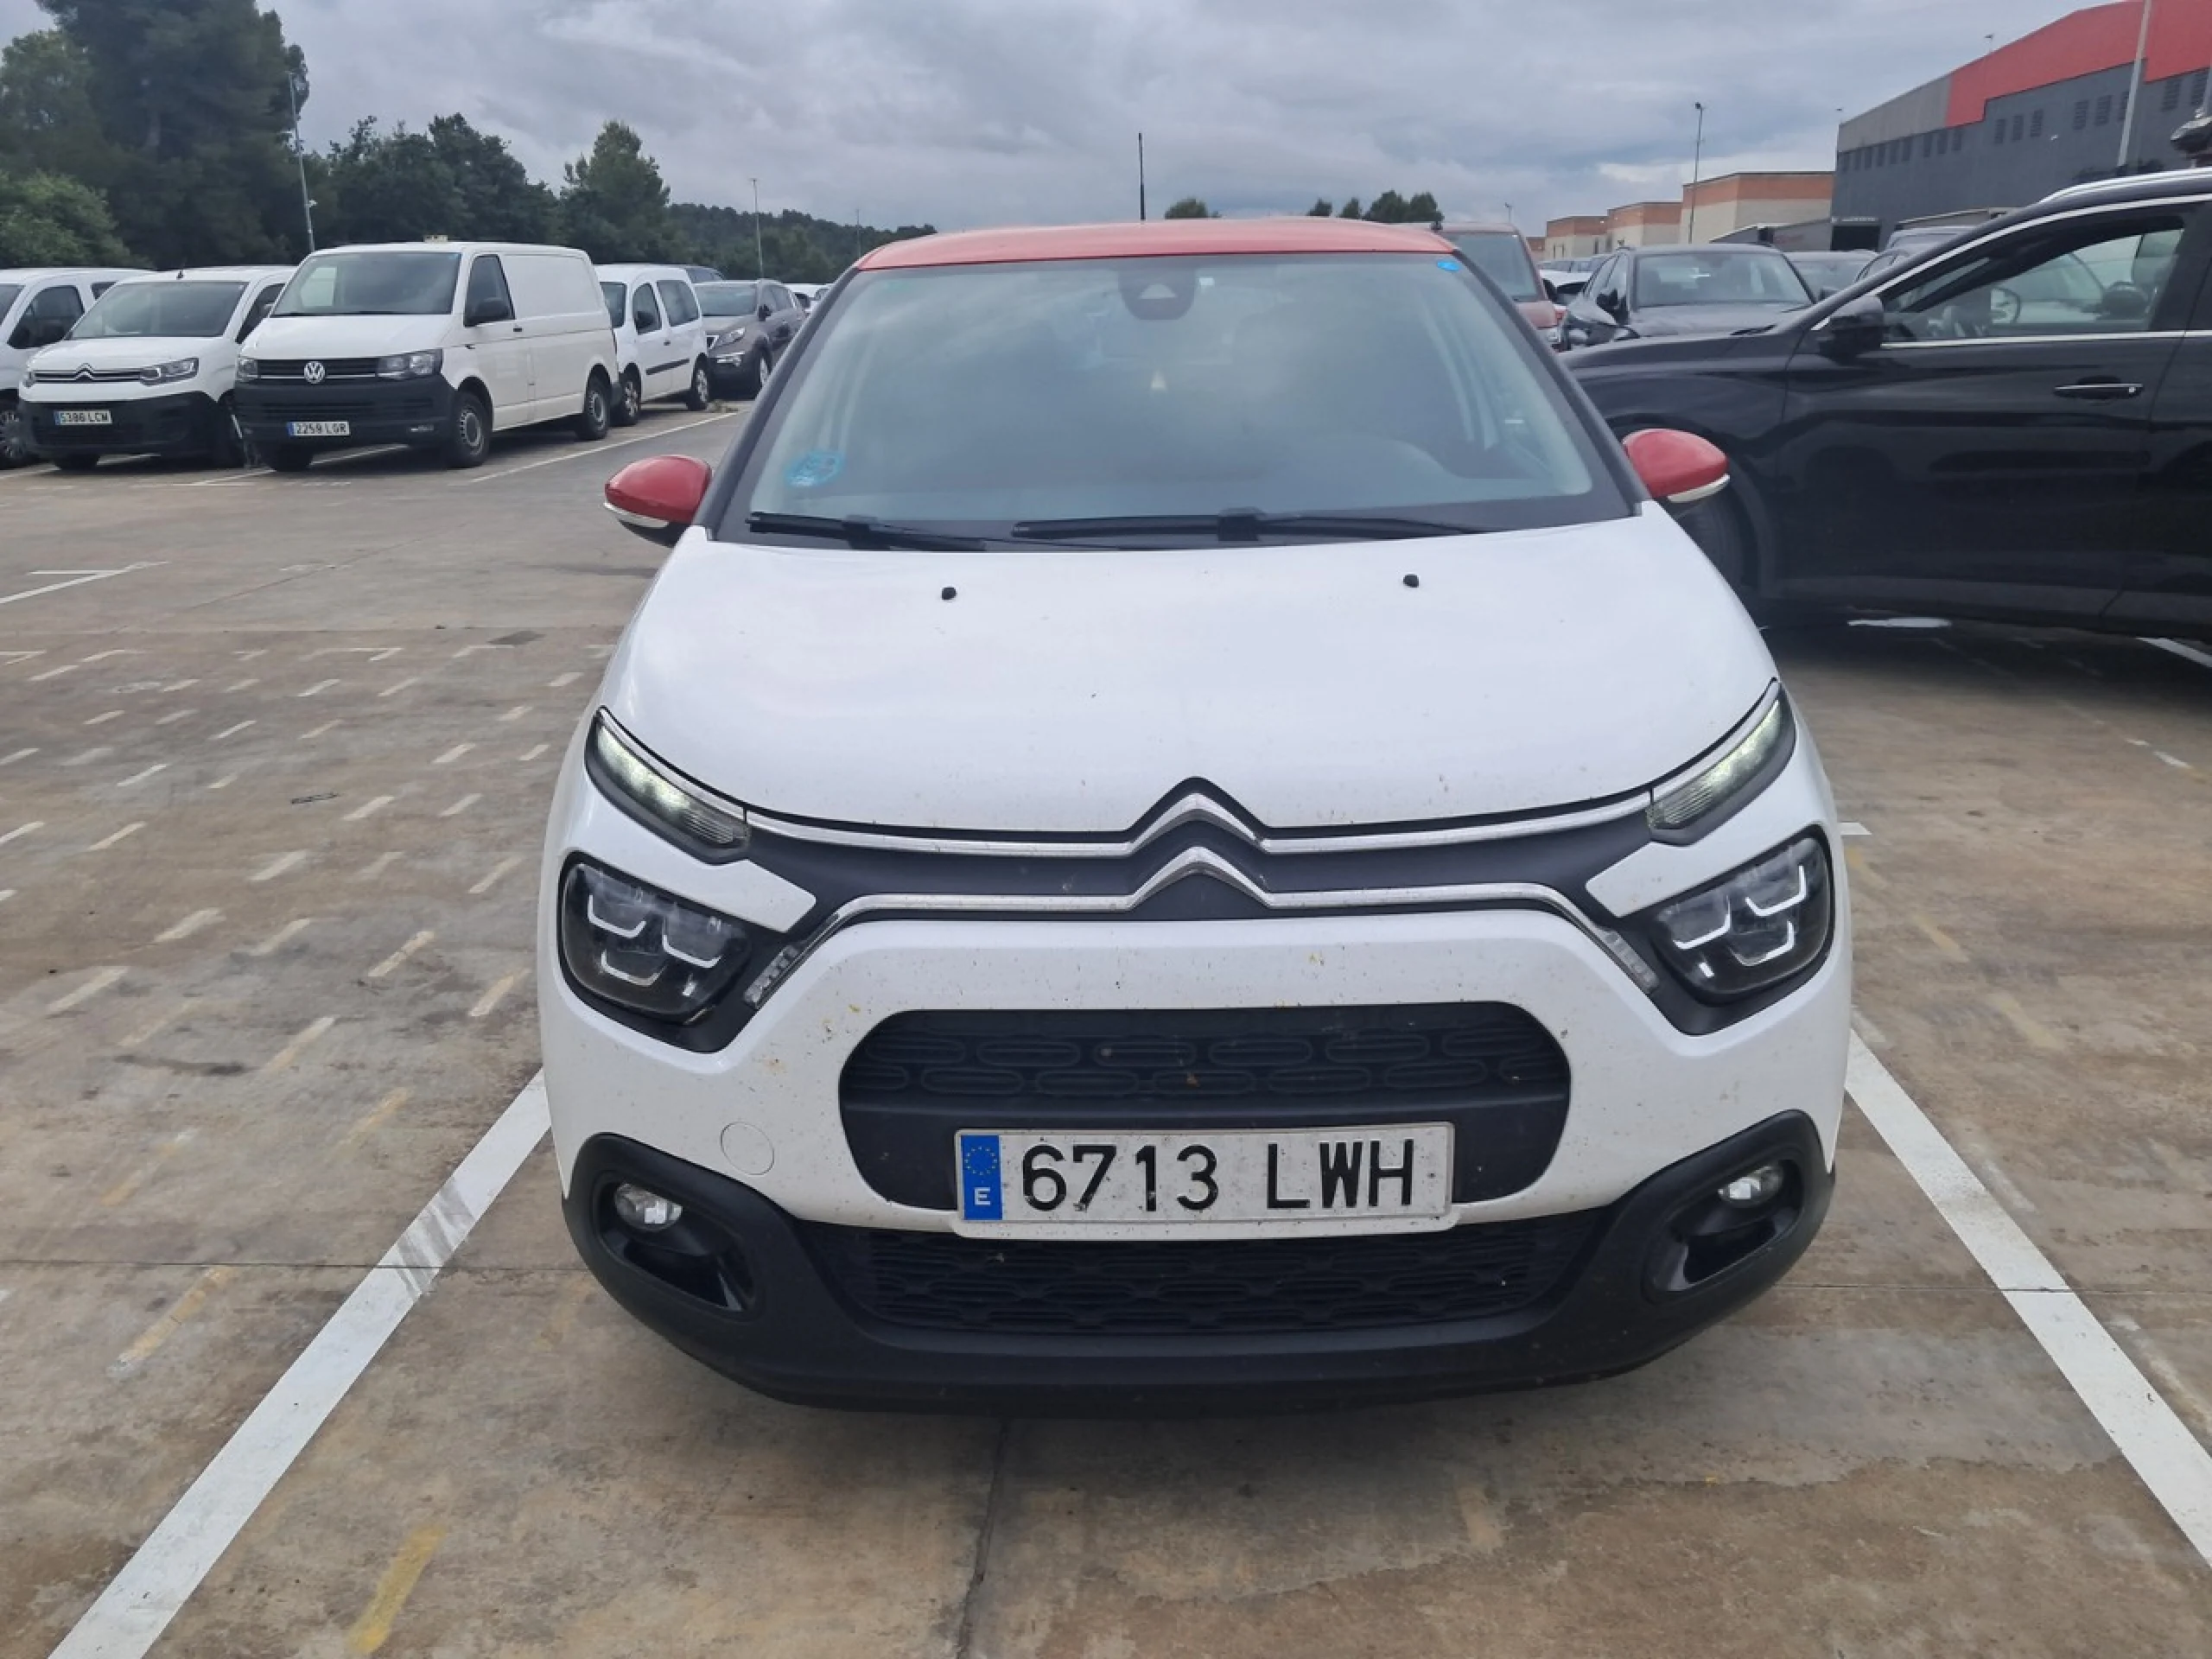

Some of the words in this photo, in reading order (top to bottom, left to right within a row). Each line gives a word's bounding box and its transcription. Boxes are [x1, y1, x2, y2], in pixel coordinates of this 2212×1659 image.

[974, 1186, 991, 1206] E
[1022, 1144, 1219, 1212] 6713
[1266, 1139, 1414, 1210] LWH
